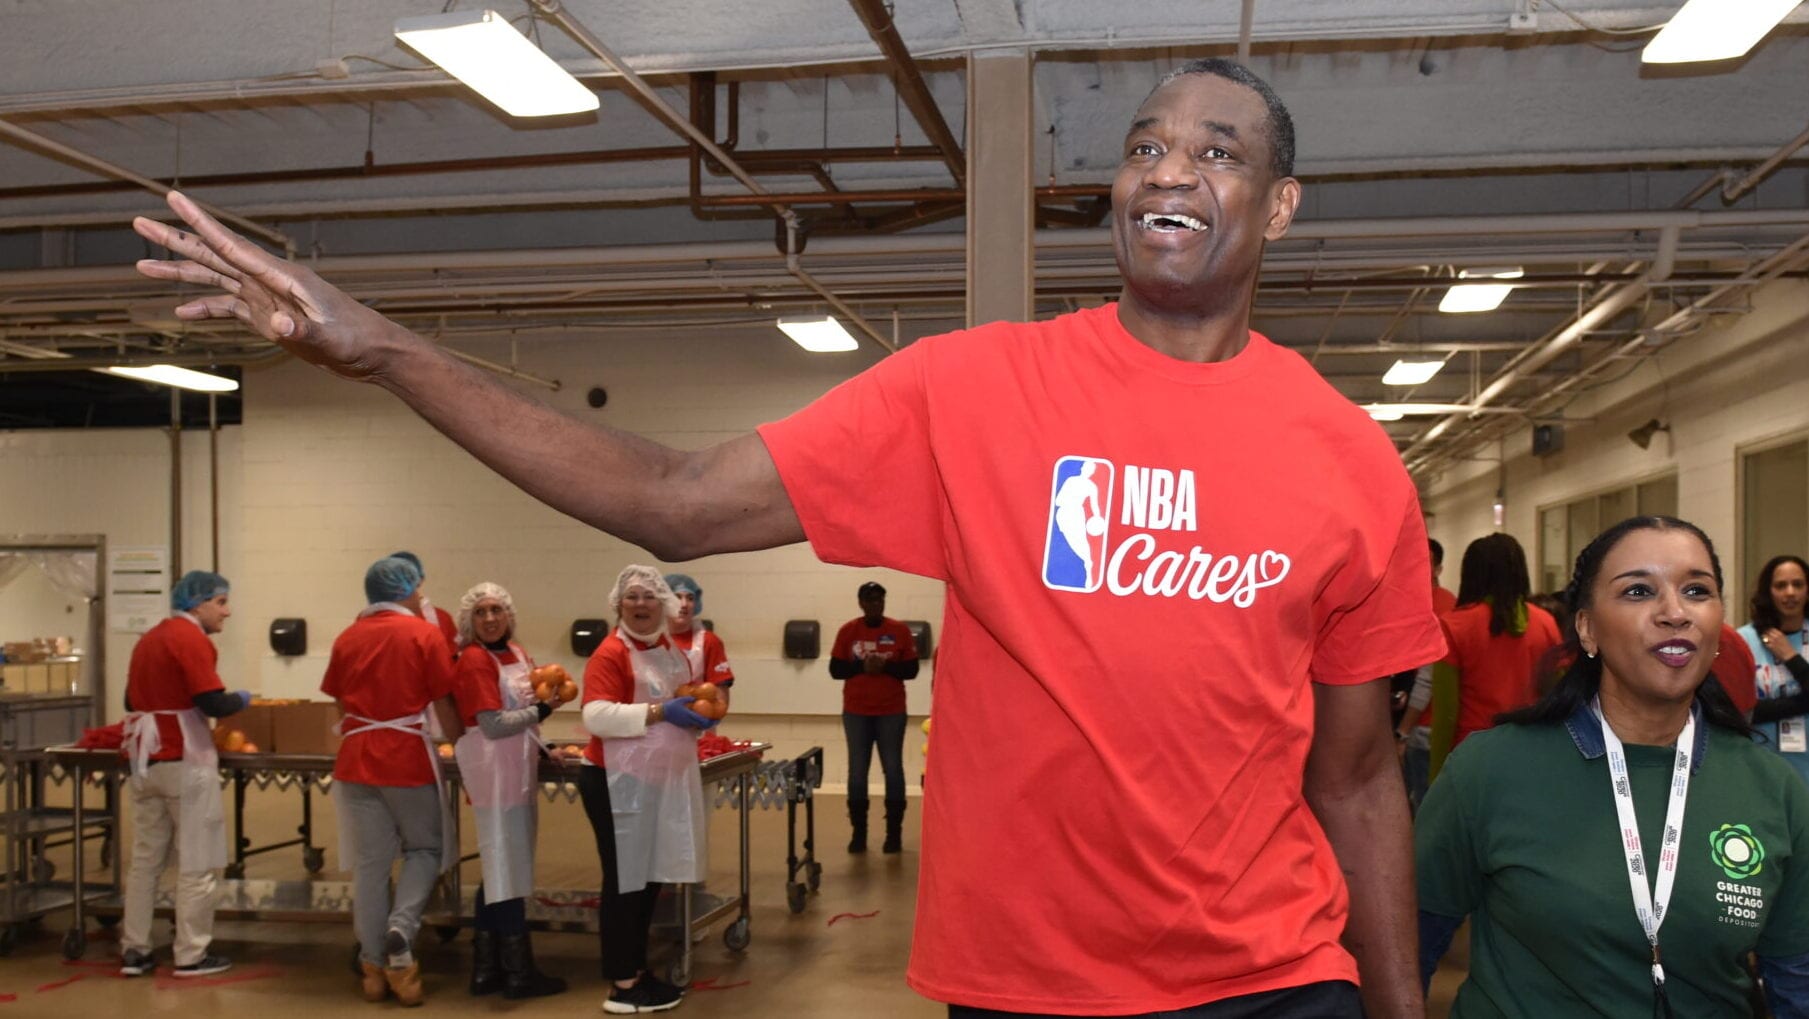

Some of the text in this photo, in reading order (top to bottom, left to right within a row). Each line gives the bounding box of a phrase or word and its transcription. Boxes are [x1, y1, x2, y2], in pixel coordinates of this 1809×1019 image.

[1121, 464, 1197, 531] NBA
[1106, 533, 1259, 608] Cares
[1717, 881, 1762, 897] GREATER
[1716, 892, 1763, 909] CHICAGO
[1727, 906, 1757, 919] FOOD
